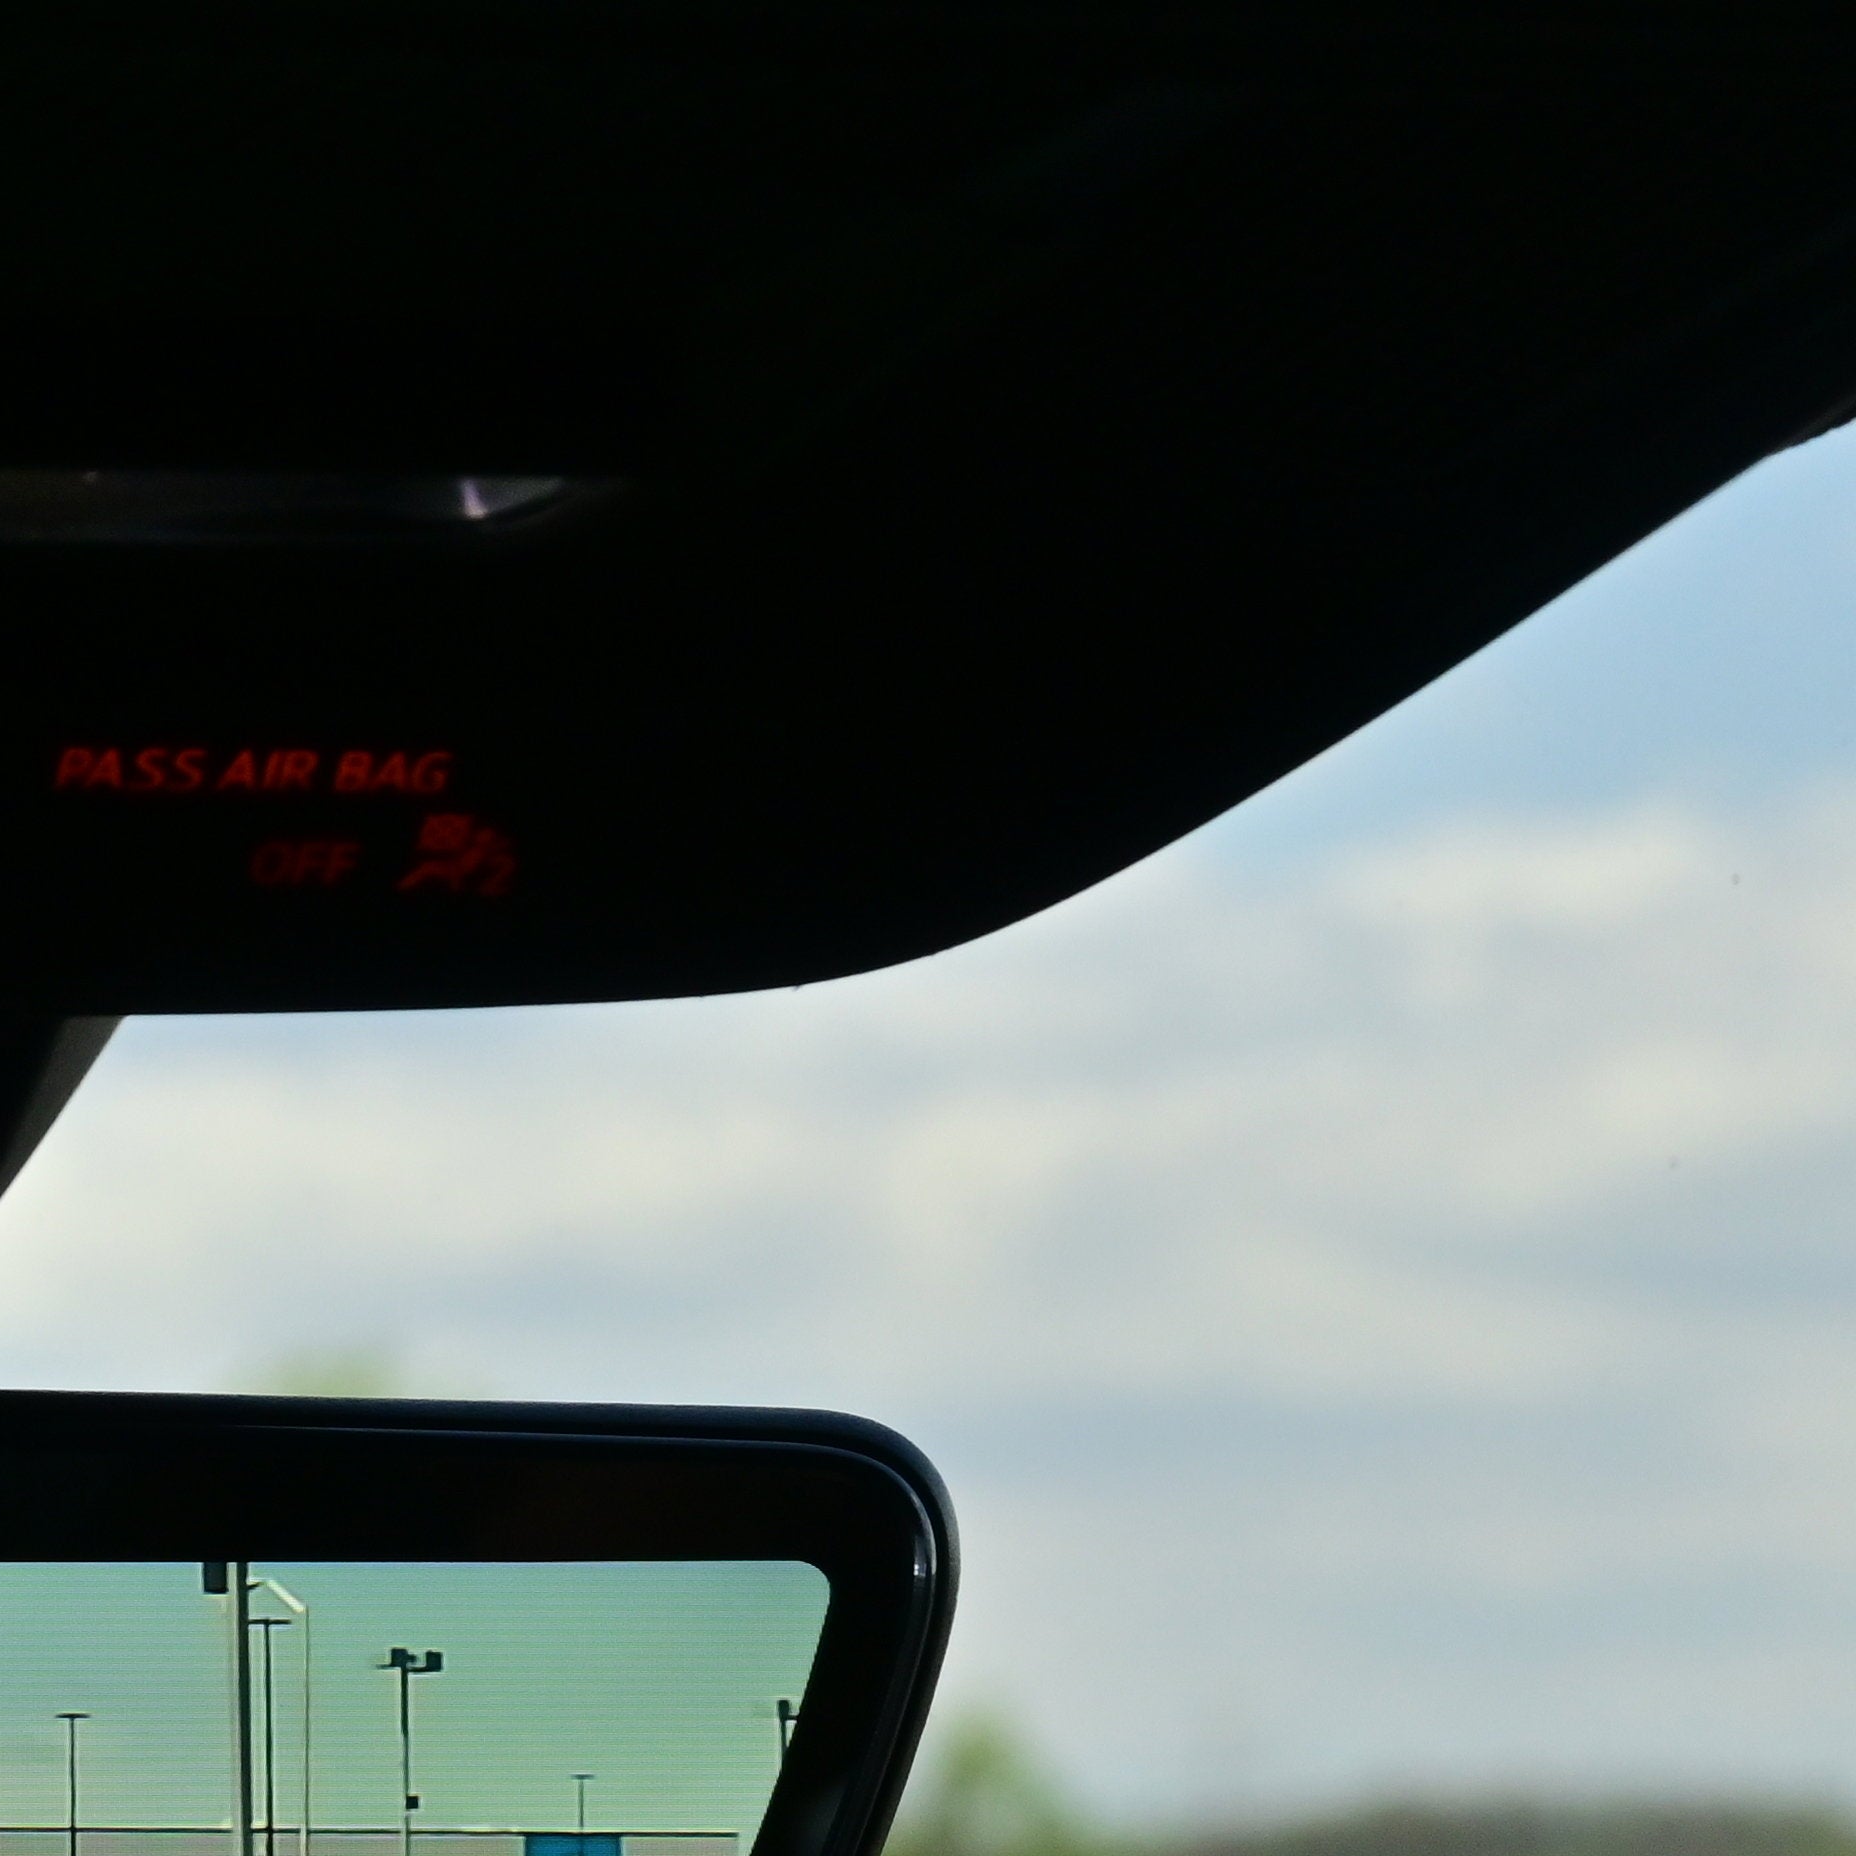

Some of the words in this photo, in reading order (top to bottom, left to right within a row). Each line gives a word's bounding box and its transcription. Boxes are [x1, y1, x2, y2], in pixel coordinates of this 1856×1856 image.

[53, 746, 208, 793] PASS
[215, 746, 322, 793] AIR
[332, 748, 454, 794] BAG
[251, 839, 360, 887] OFF
